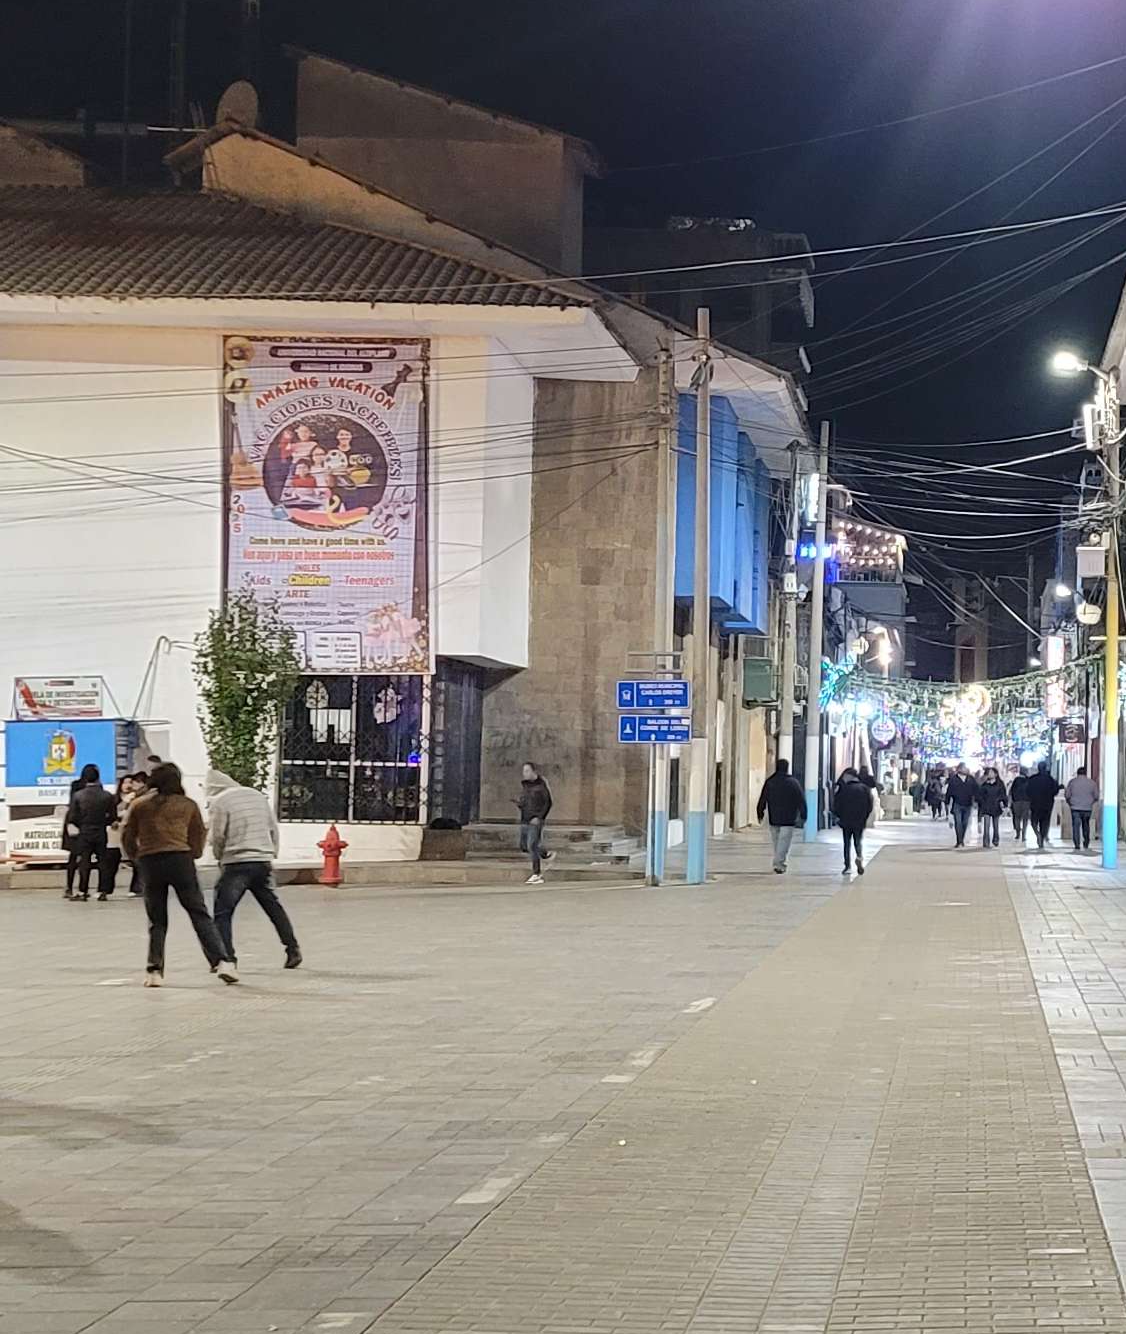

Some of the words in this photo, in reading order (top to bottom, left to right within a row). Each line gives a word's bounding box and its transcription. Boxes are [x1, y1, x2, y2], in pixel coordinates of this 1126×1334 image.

[256, 376, 318, 409] AMAZING
[328, 377, 396, 410] VACATION
[249, 396, 333, 463] VACACIONES
[344, 575, 395, 587] Teenagers
